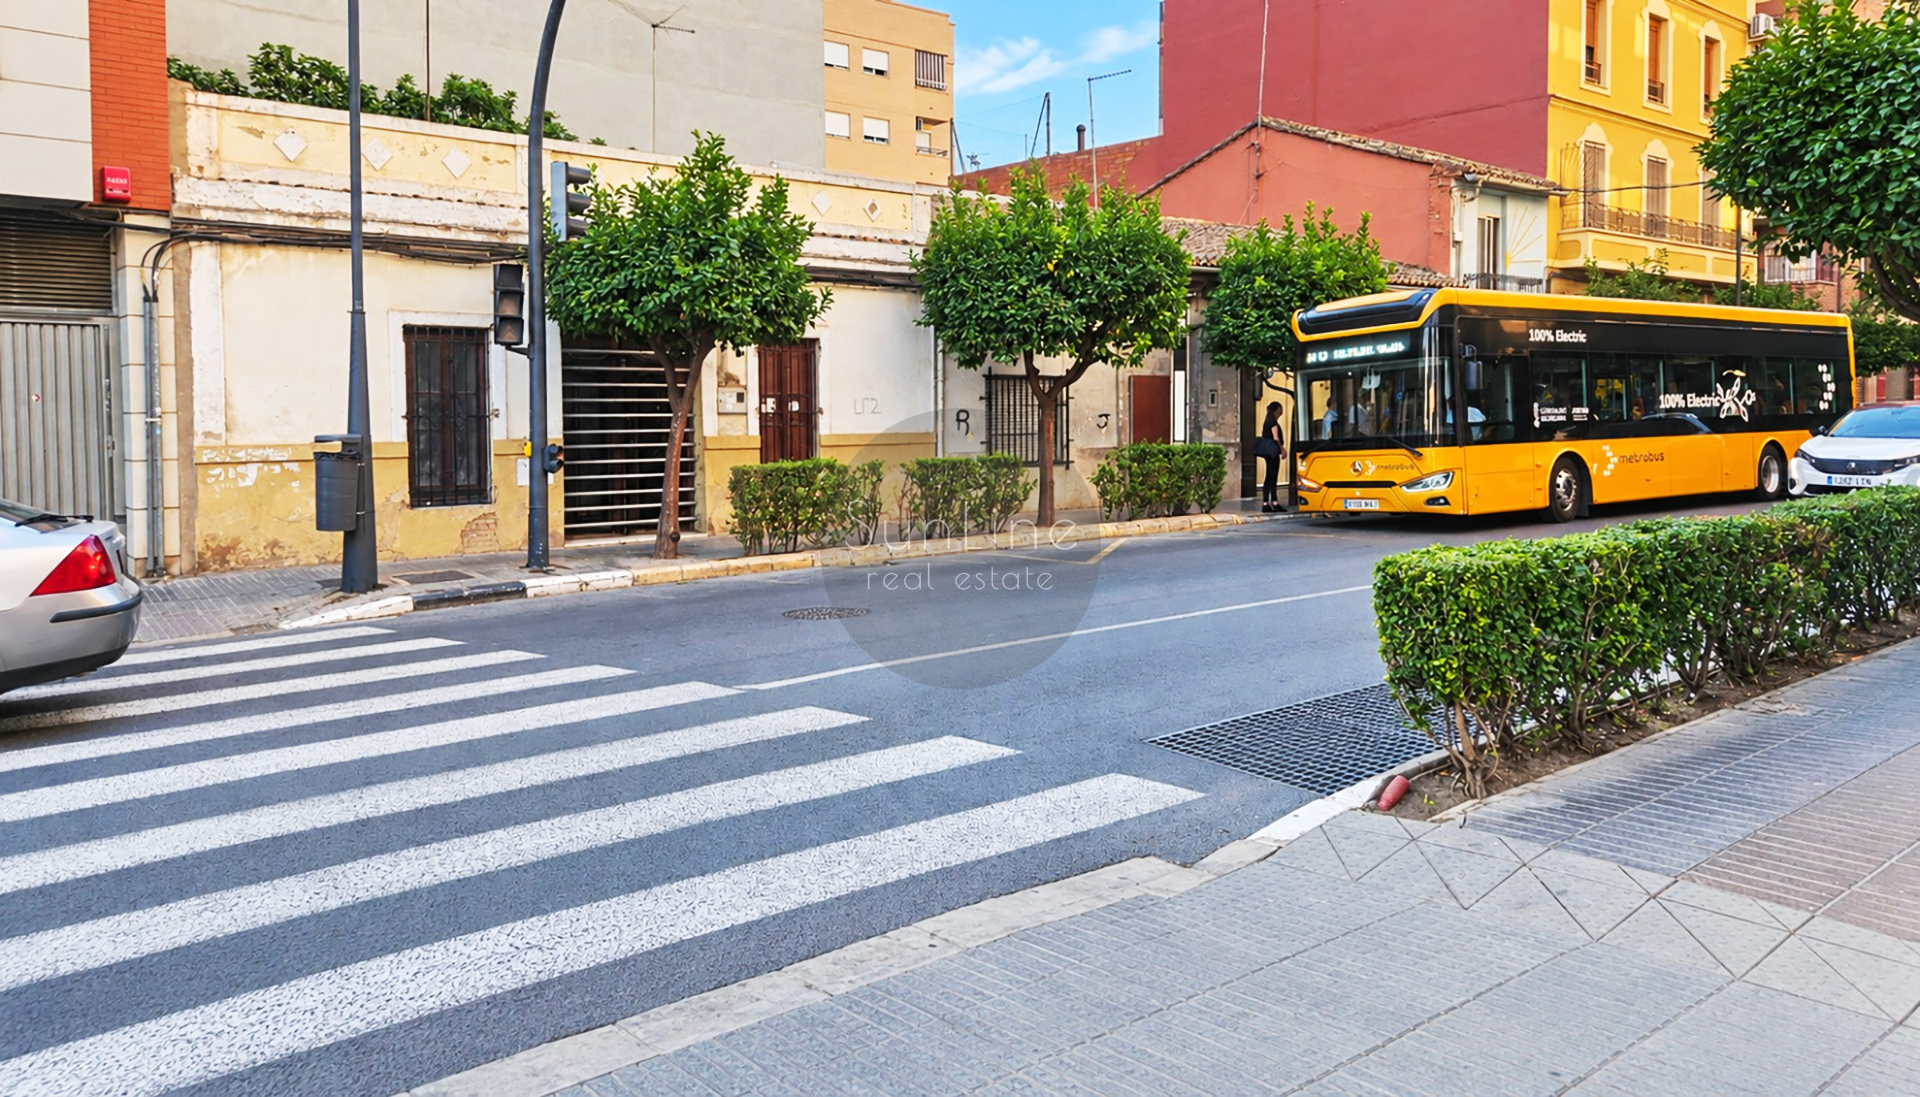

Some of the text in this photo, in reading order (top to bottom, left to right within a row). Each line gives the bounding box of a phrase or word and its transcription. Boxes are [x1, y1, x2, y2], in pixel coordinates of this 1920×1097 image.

[1529, 329, 1587, 342] 100% Electric
[1660, 392, 1720, 408] 100% Electric
[1619, 451, 1664, 464] metrobus
